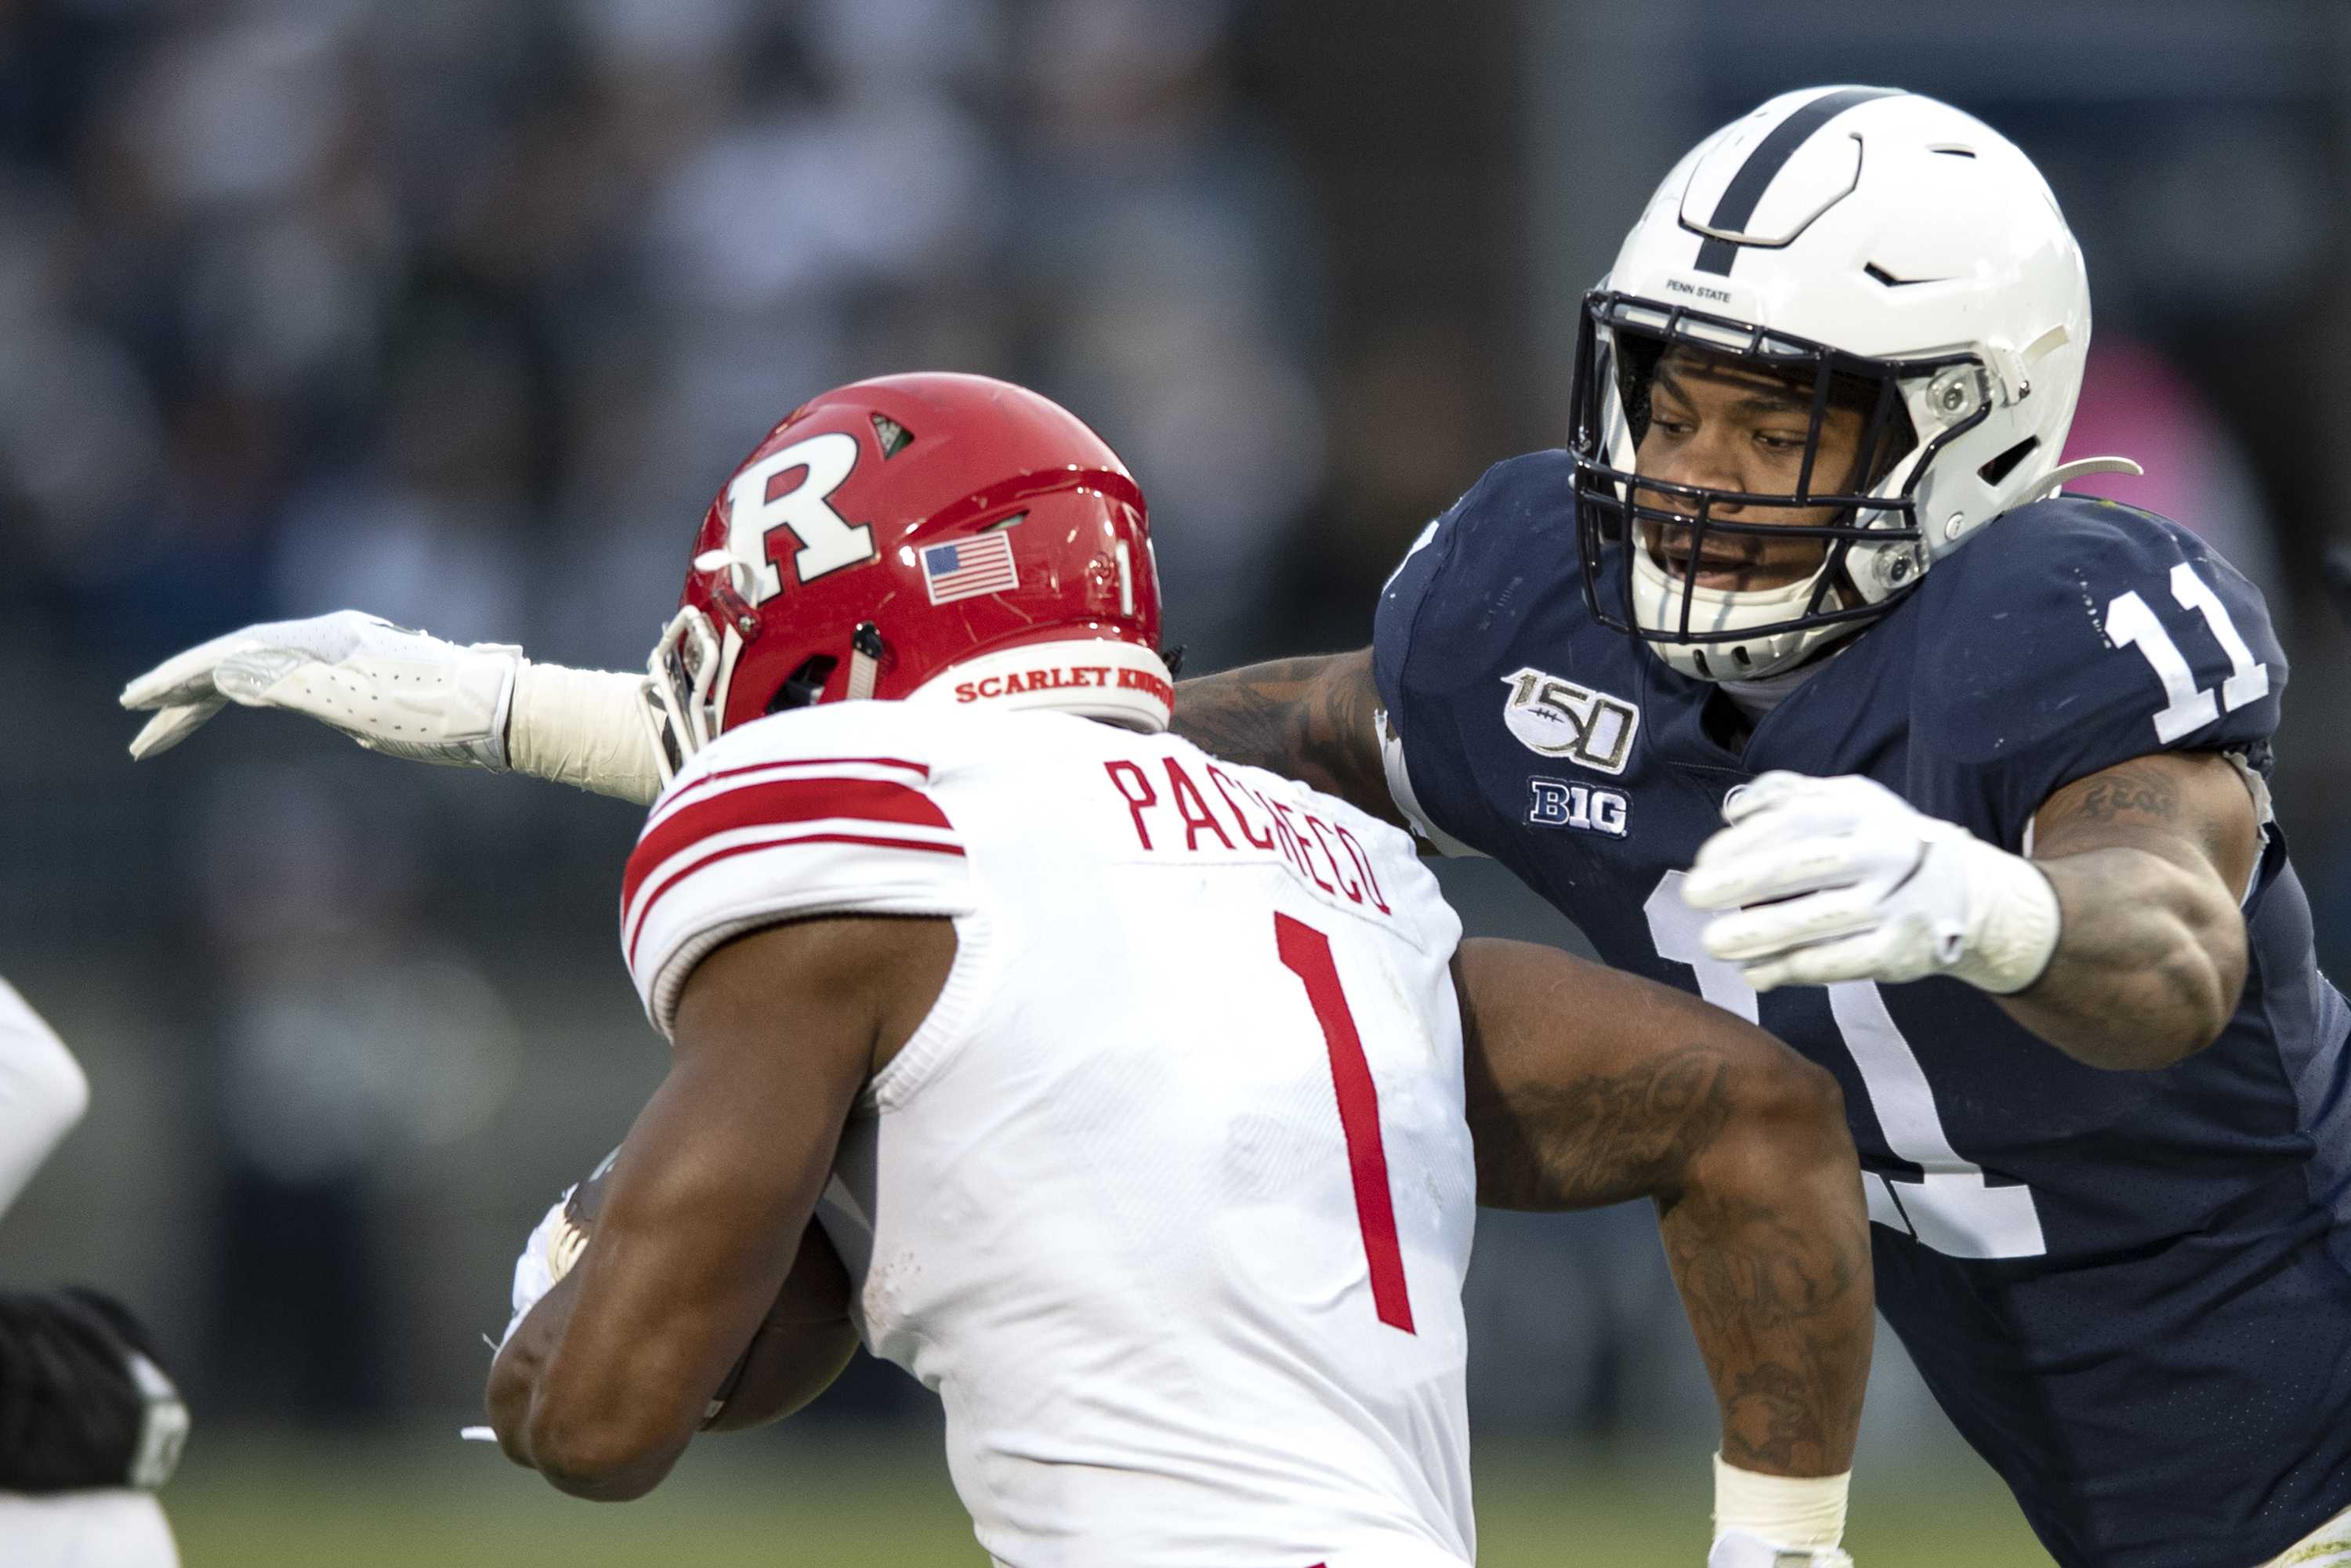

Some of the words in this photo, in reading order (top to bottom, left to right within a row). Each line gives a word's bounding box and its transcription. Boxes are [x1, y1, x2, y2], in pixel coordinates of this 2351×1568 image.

[1667, 280, 1694, 294] PENN
[1697, 287, 1730, 302] STATE
[726, 432, 875, 603] R
[955, 666, 1112, 703] SCARLET
[1500, 667, 1640, 774] 150
[2105, 562, 2269, 744] 11
[1274, 911, 1417, 1337] 1
